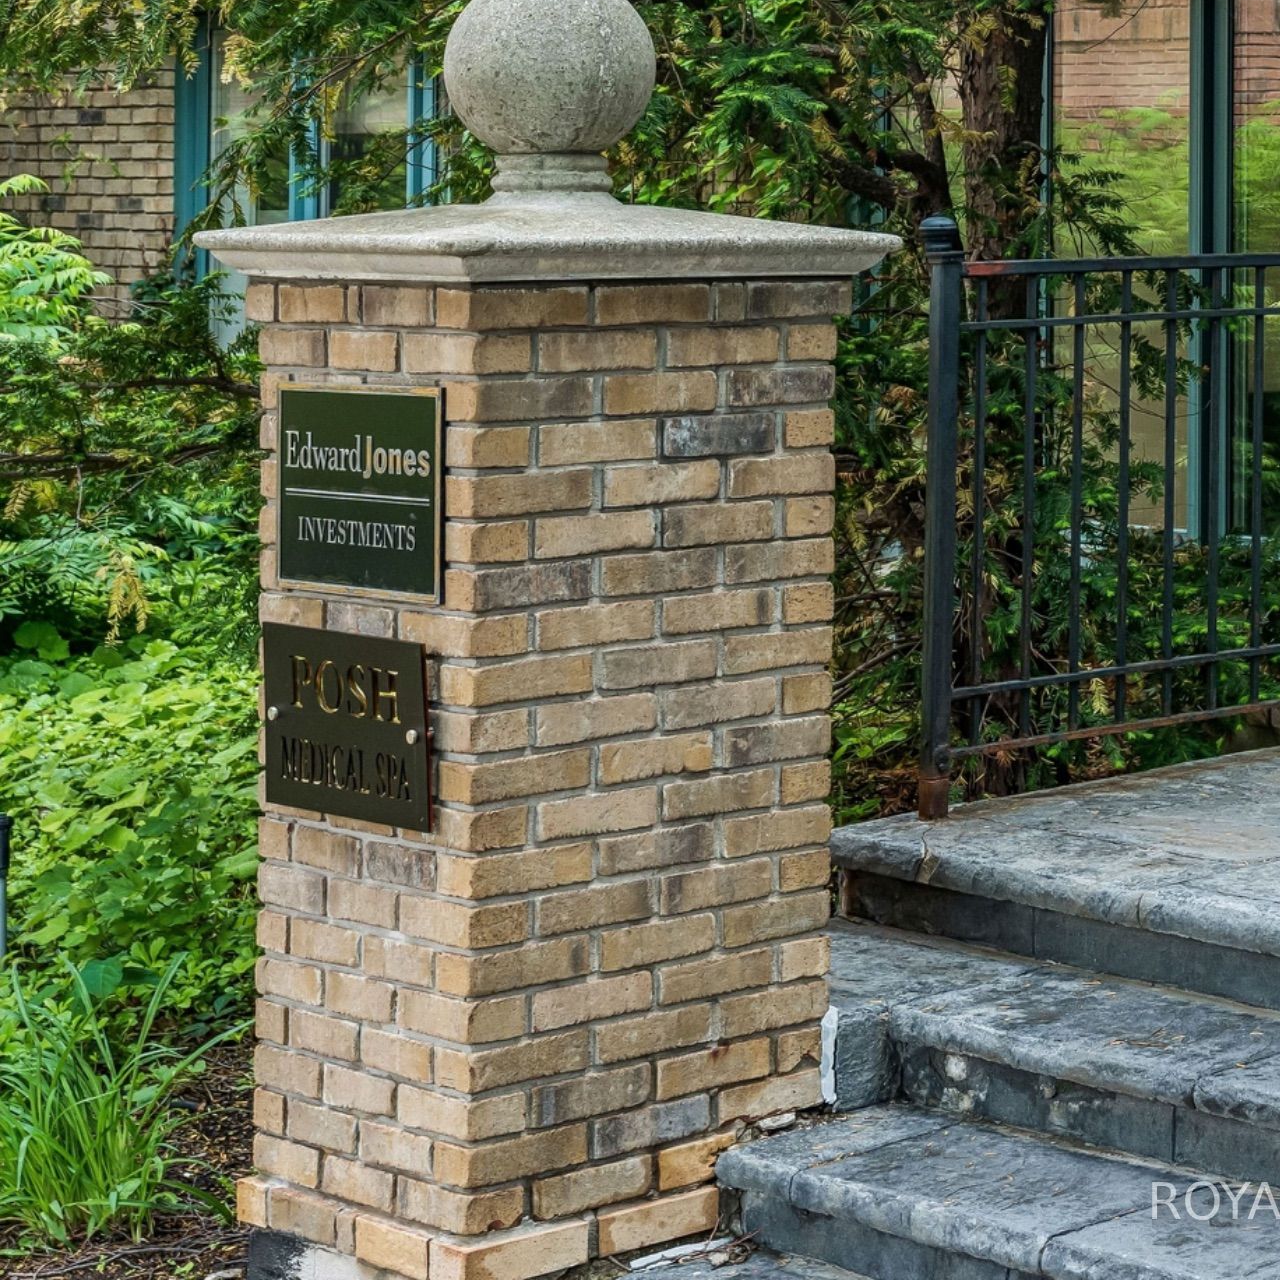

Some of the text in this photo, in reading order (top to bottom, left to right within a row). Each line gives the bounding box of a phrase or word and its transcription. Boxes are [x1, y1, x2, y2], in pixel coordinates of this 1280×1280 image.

[298, 516, 416, 551] INVESTMENTS
[289, 654, 401, 724] POSH
[281, 735, 413, 802] MEDICAL SPA
